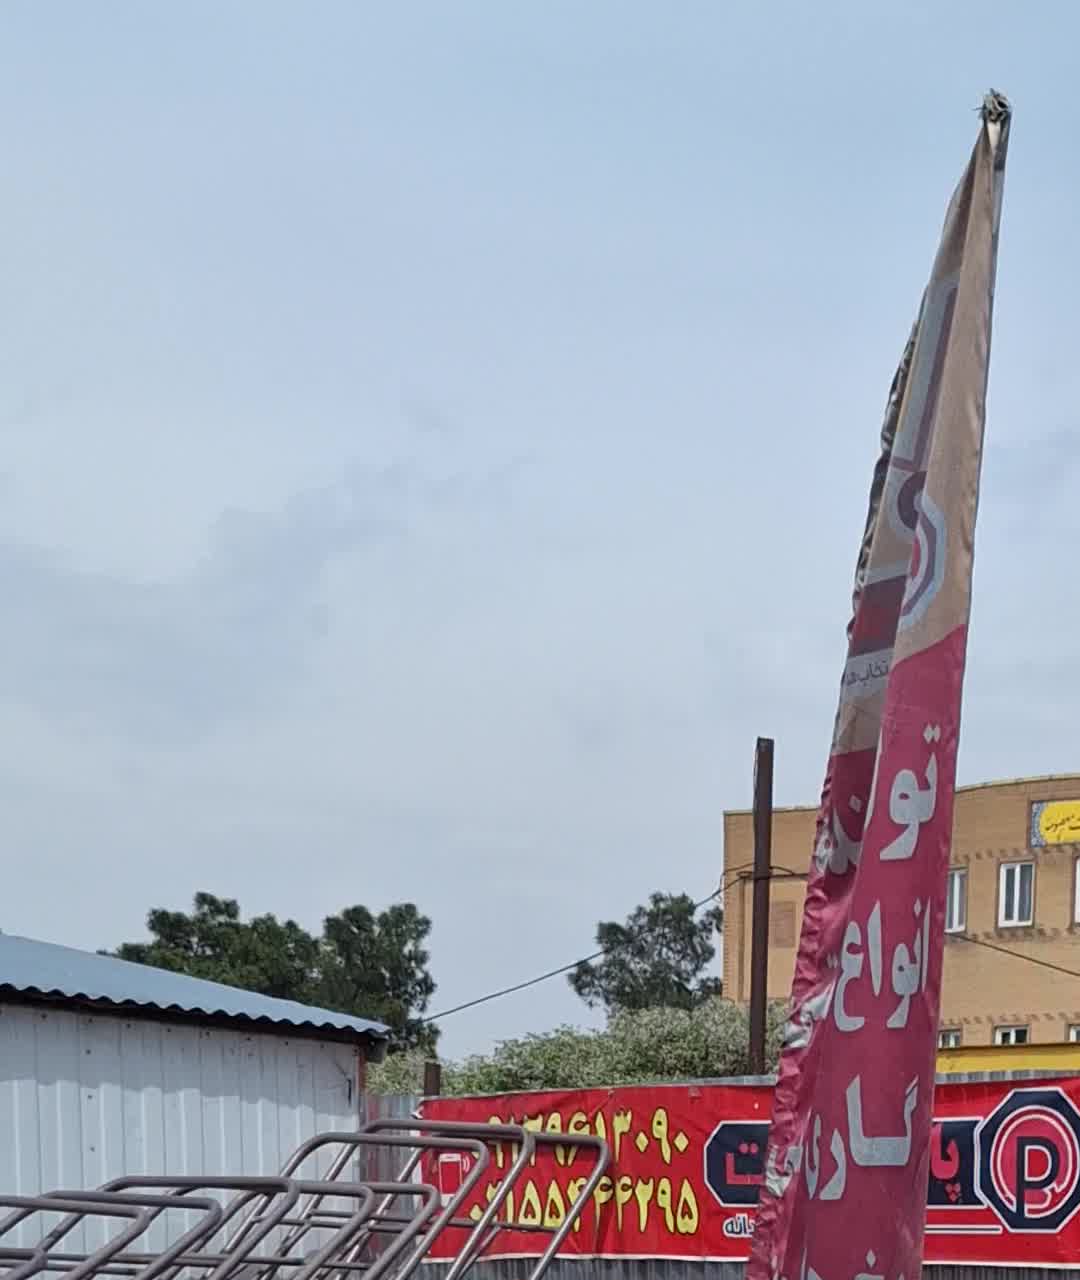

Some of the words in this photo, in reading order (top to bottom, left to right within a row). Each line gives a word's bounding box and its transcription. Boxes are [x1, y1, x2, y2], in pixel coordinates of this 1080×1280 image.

[834, 896, 930, 1032] انواع
[472, 1107, 689, 1168] ۹۱۲۹۶۱۳۰۹۰
[930, 1122, 961, 1203] پا
